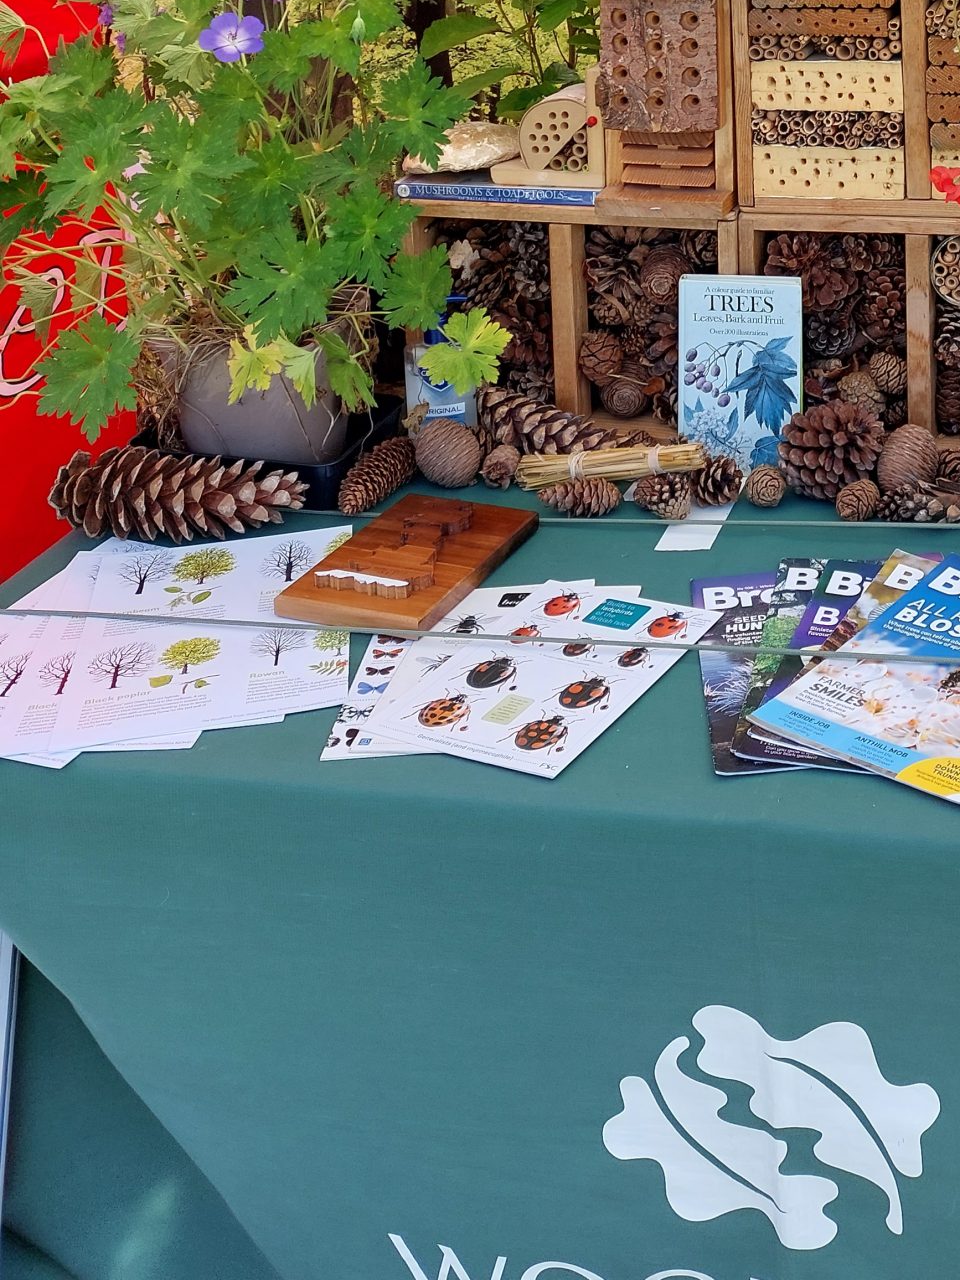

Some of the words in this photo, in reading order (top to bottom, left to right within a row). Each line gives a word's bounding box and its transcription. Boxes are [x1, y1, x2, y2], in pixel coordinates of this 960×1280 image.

[415, 184, 483, 197] MUSHROOMS
[485, 188, 496, 197] &
[711, 286, 730, 294] colour
[730, 287, 746, 295] guide
[752, 287, 775, 295] familiar
[704, 294, 774, 314] TREES
[693, 312, 725, 323] Leaves,
[725, 313, 746, 323] Bark
[746, 314, 763, 324] and
[764, 315, 785, 325] Fruit
[736, 328, 769, 337] illustrations
[426, 405, 463, 415] RIGINAL
[601, 605, 634, 617] ladybirds
[907, 598, 946, 619] ALL
[734, 615, 767, 624] SEED
[725, 621, 767, 634] HUN
[249, 670, 286, 679] Rowan
[818, 675, 866, 696] FARMER
[84, 694, 115, 705] Black
[117, 690, 152, 703] poplar
[809, 683, 868, 708] SMILES
[27, 702, 58, 711] Black
[788, 710, 815, 724] INSIDE
[814, 719, 831, 729] JOB
[855, 735, 889, 752] ANTHILL
[888, 747, 910, 759] MOB
[935, 763, 960, 776] DOWN
